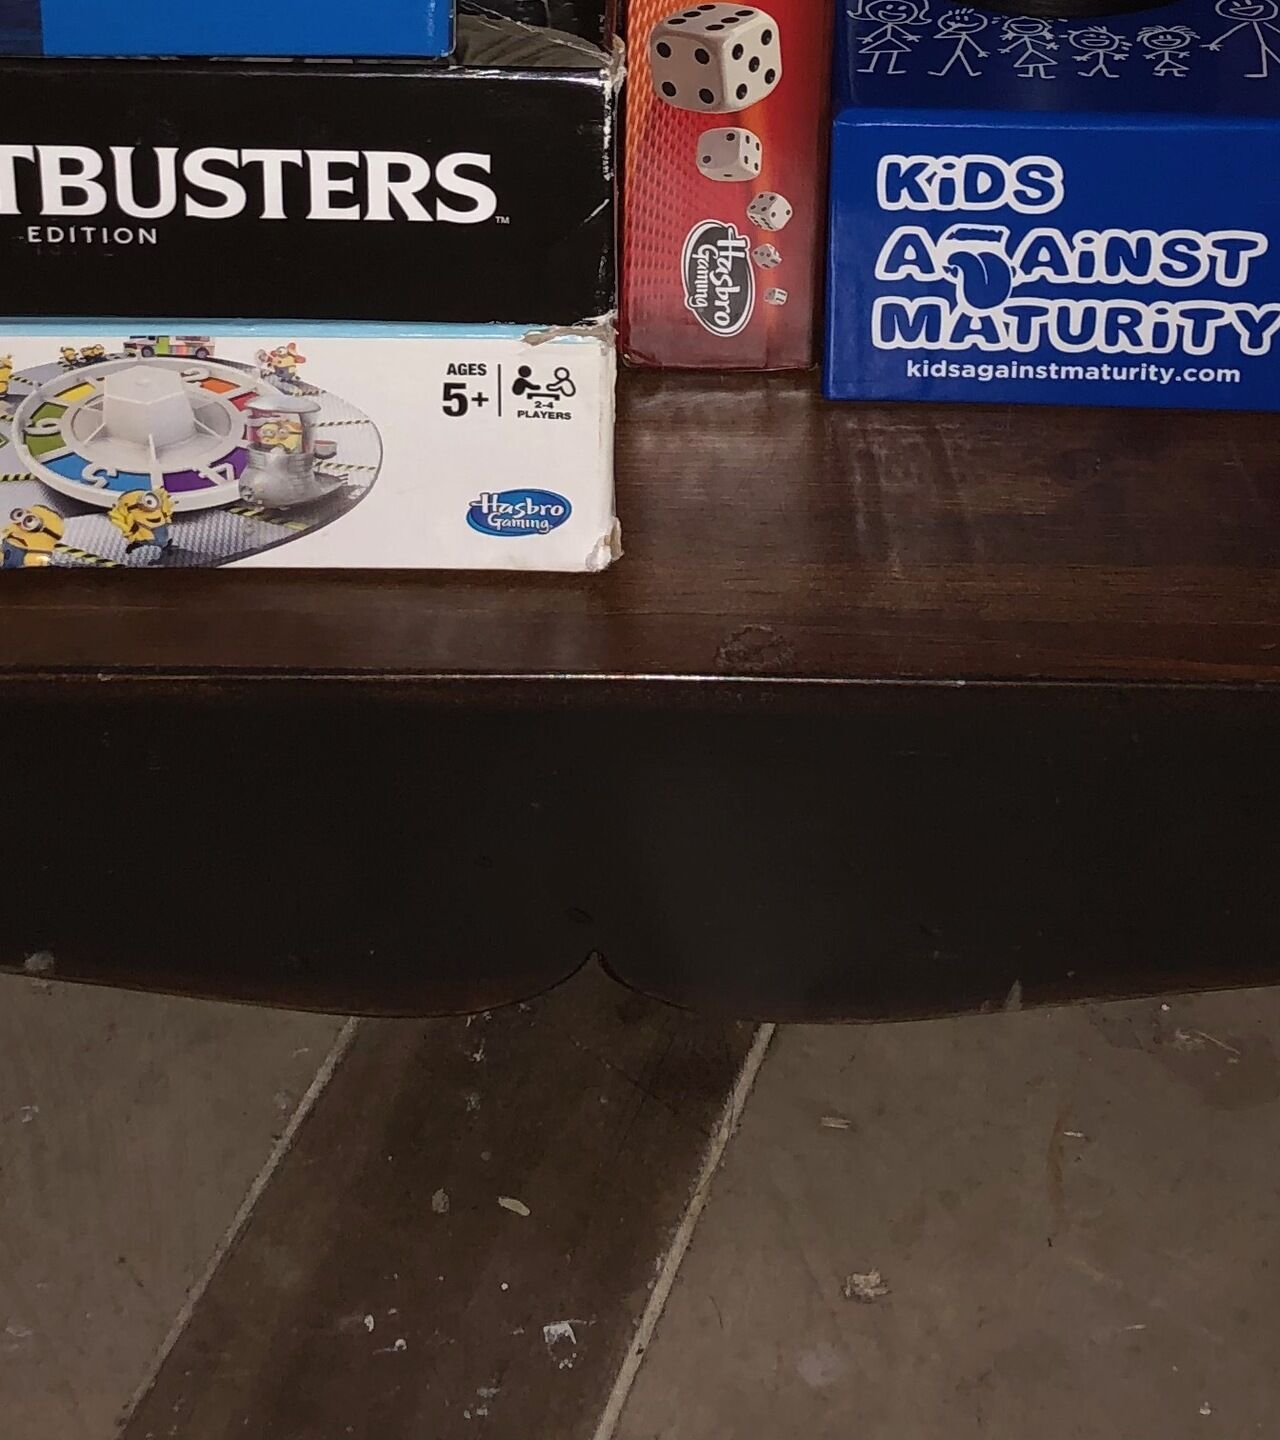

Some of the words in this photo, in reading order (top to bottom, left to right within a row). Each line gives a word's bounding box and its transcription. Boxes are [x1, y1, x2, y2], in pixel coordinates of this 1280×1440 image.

[27, 226, 158, 246] EDITION
[692, 242, 716, 310] Gaming
[712, 225, 747, 328] Hasbro
[446, 362, 487, 377] AGES
[907, 360, 1241, 385] kidsagainstmaturity.com
[442, 382, 489, 417] 5+
[534, 400, 555, 410] 2-4
[517, 409, 573, 421] PLAYERS
[470, 492, 565, 519] Hasbro
[487, 512, 552, 533] Gaming
